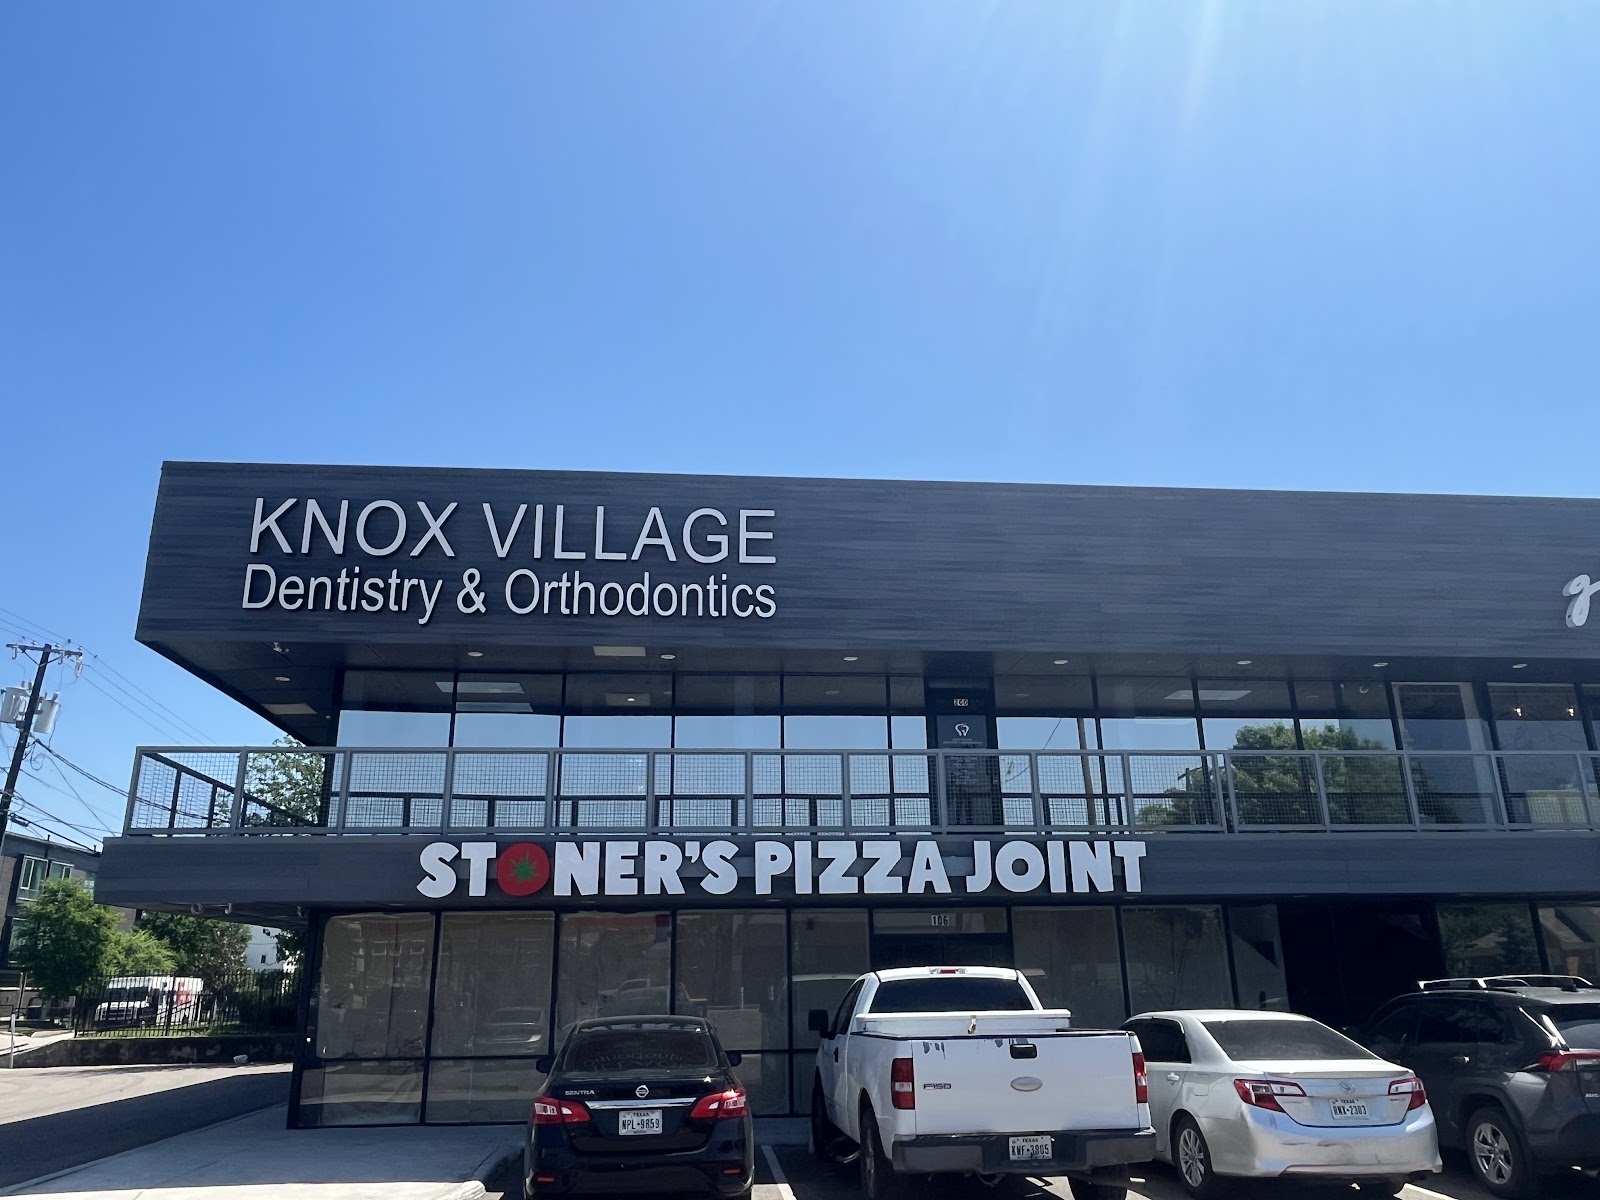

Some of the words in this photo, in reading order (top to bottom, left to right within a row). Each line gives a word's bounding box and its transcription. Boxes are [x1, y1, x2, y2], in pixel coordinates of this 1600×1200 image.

[249, 497, 458, 557] KNOX
[482, 502, 777, 564] VILLAGE
[242, 563, 443, 625] Dentistry
[456, 568, 487, 614] &
[505, 568, 777, 618] Orthodontics
[754, 840, 953, 896] PIZZA
[966, 840, 1148, 894] JOINT
[932, 915, 949, 926] 106
